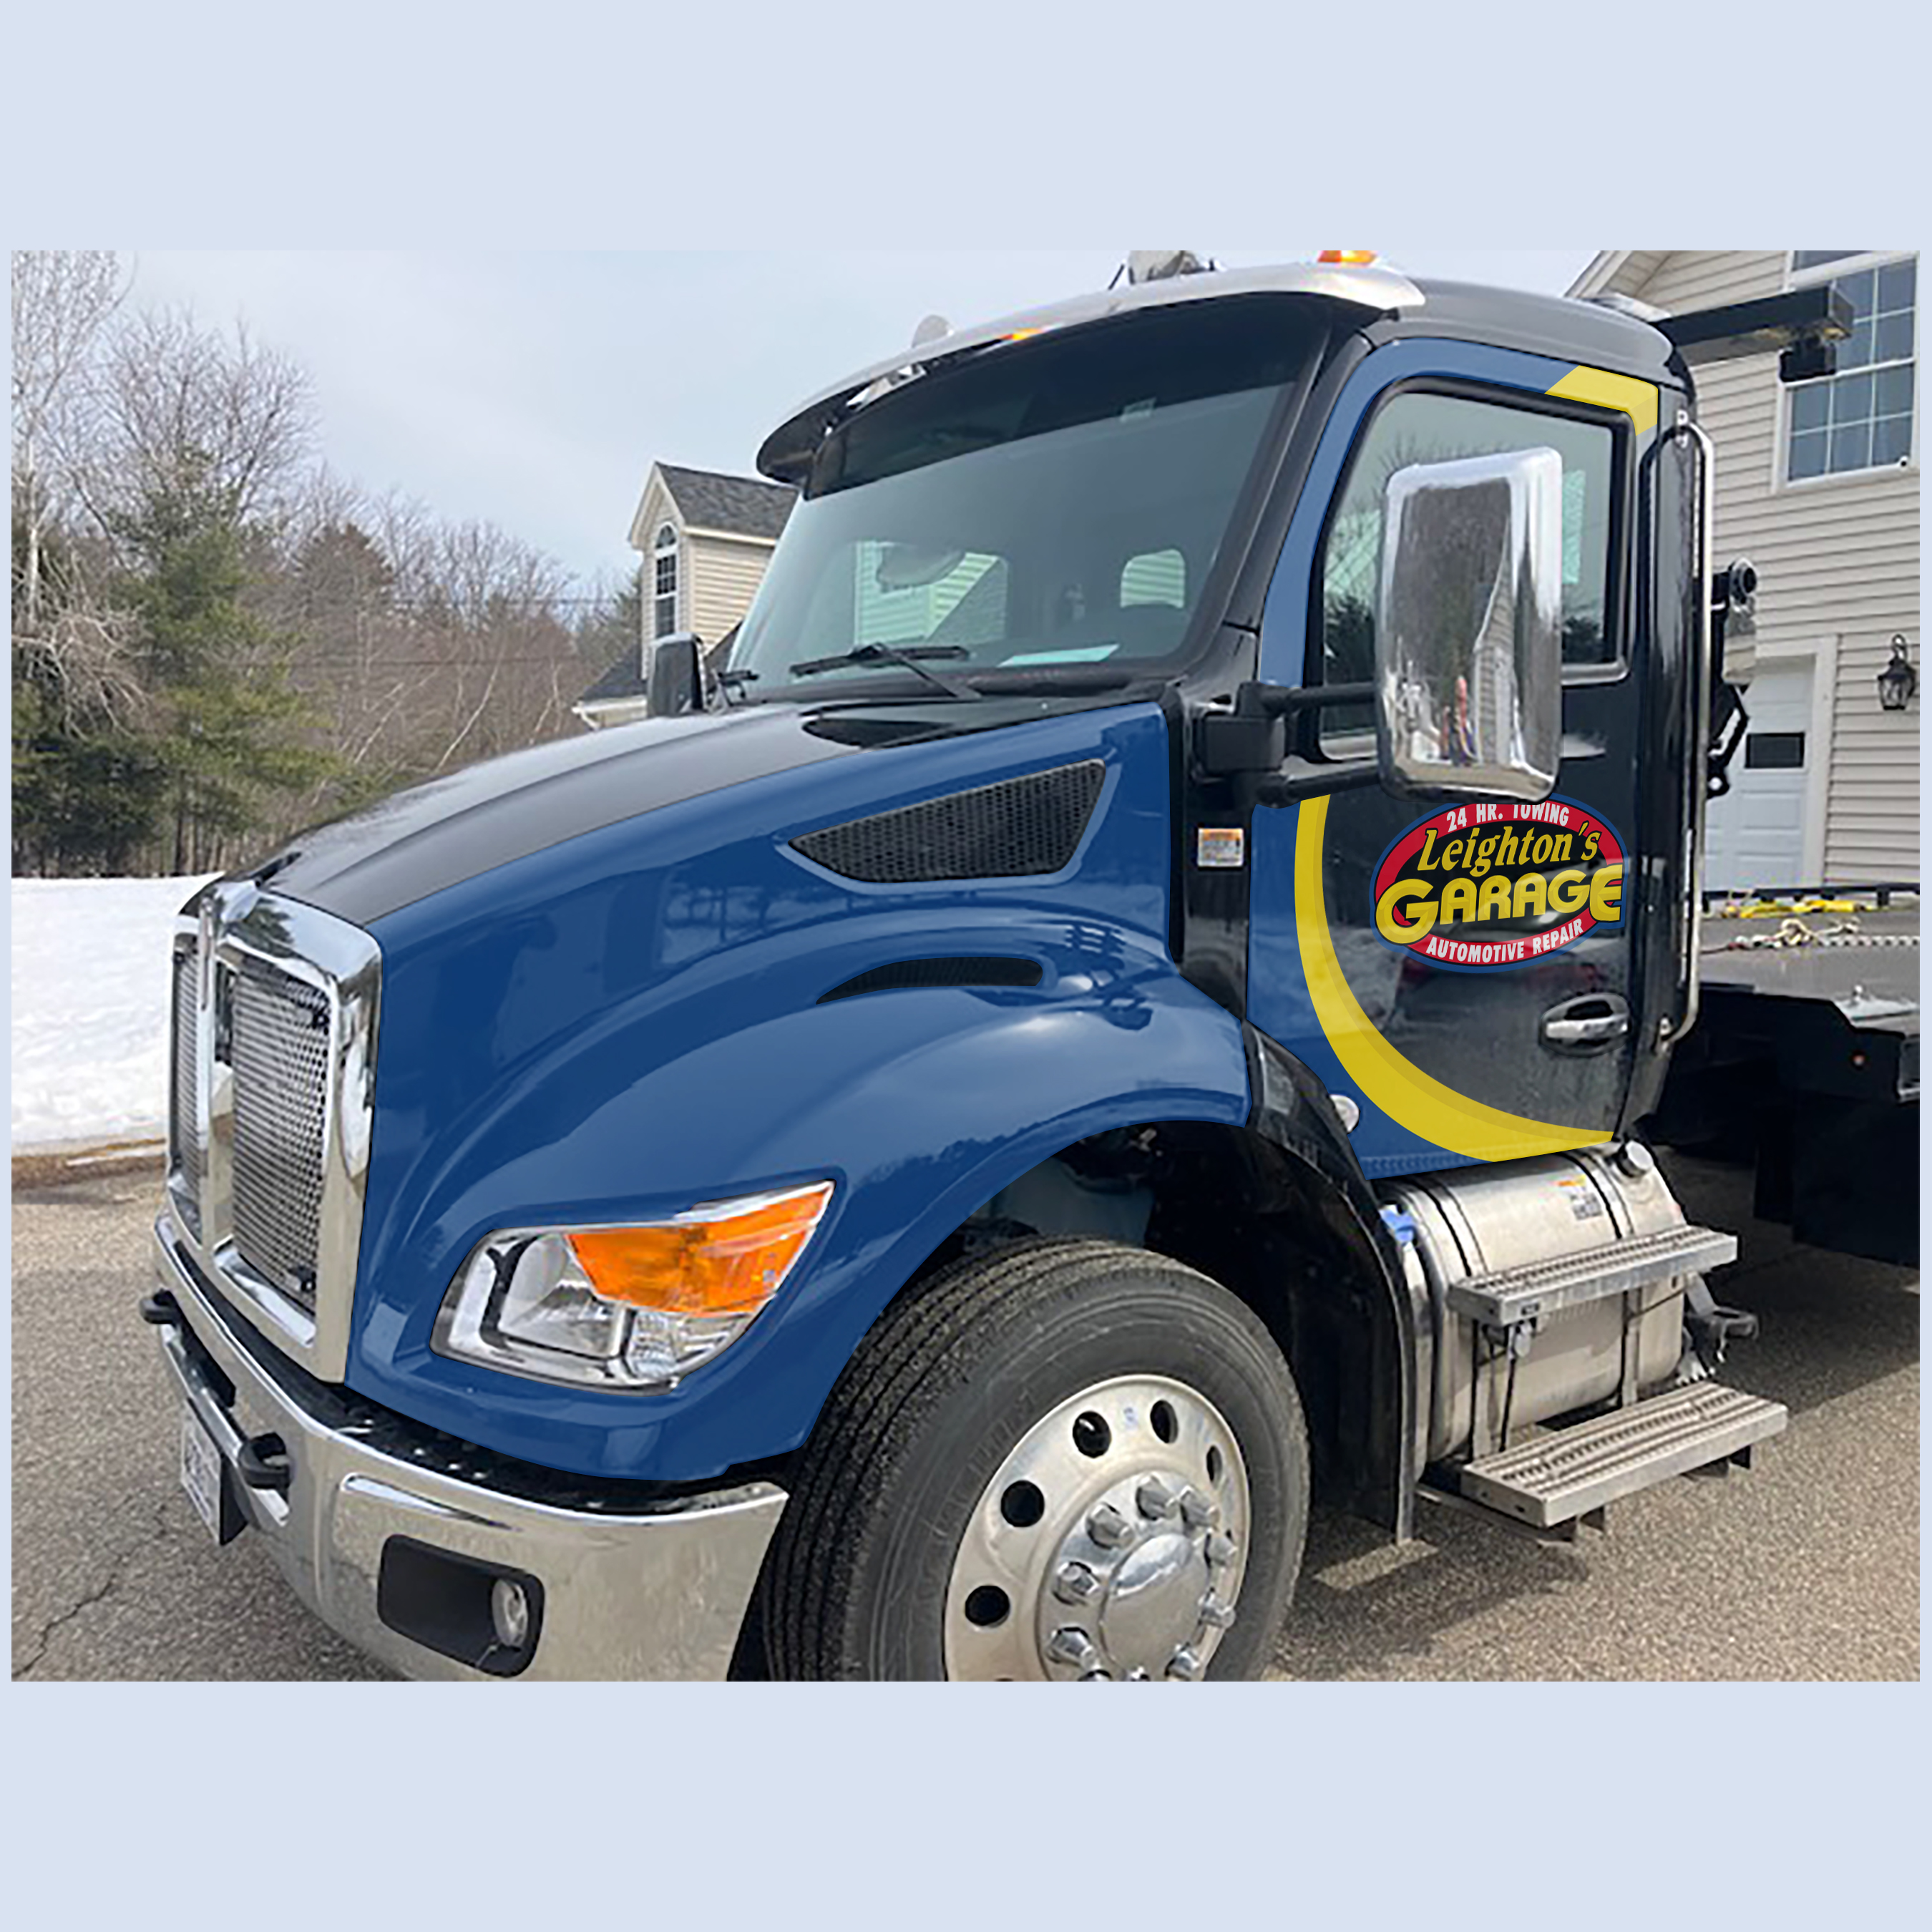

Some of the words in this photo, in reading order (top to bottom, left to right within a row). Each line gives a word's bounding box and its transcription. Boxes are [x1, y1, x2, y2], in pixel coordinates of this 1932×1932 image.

[1447, 808, 1467, 833] 24
[1476, 804, 1503, 824] HR.
[1513, 802, 1569, 826] TOWING
[1418, 821, 1602, 877] Leighton's
[1376, 864, 1623, 944] GARAGE
[1426, 937, 1524, 963] AUTOMOTIVE
[1533, 918, 1584, 955] REPAIR
